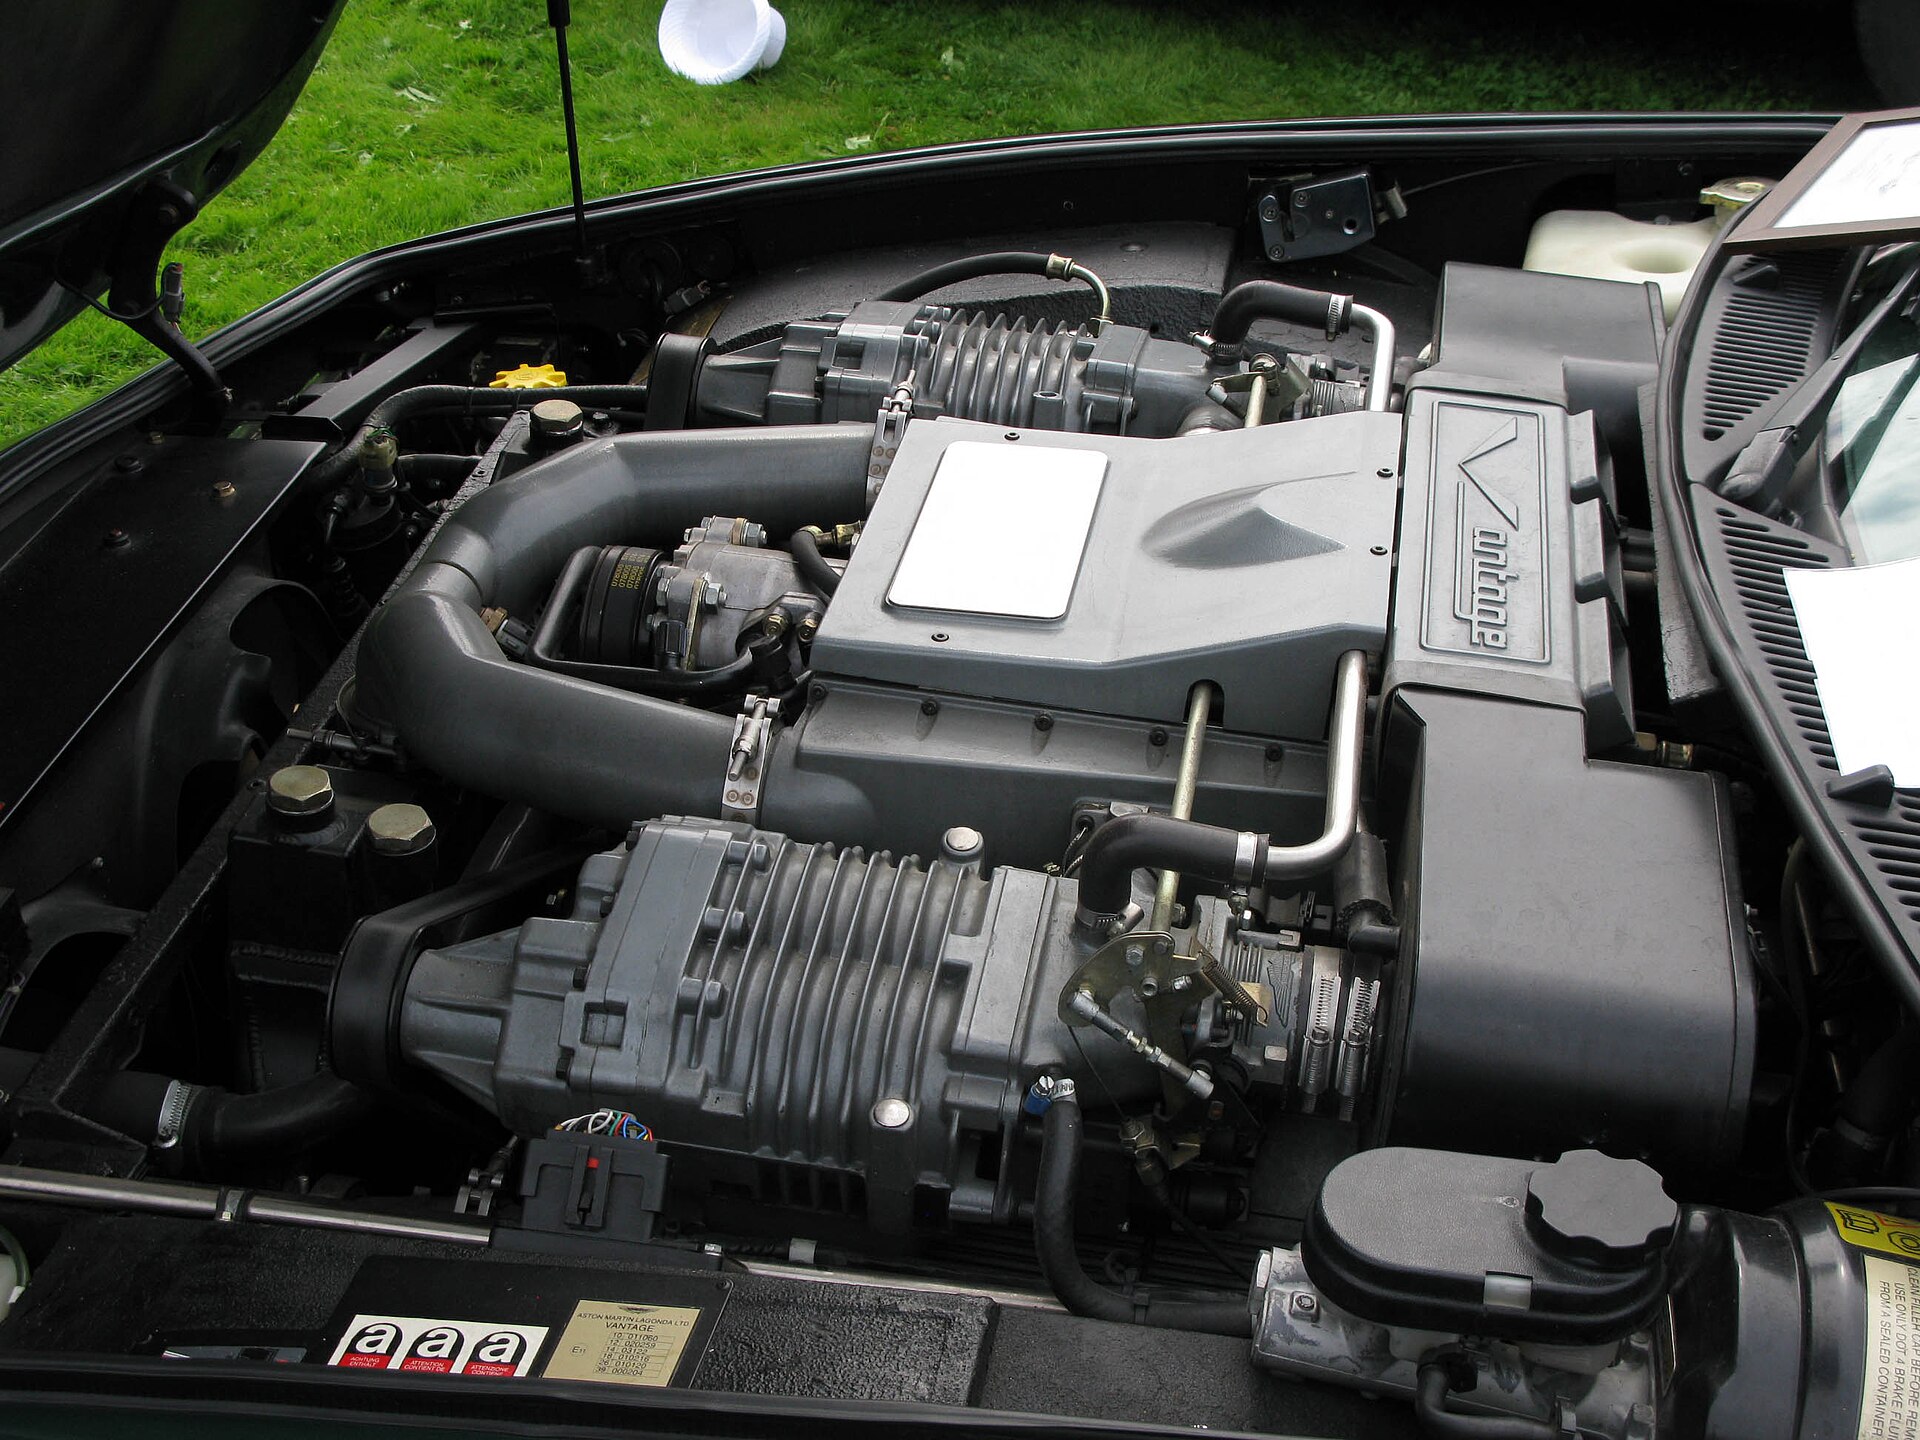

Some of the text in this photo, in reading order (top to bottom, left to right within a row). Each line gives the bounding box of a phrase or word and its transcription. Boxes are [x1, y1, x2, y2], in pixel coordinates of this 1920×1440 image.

[1879, 1280, 1891, 1308] FROM
[1894, 1282, 1905, 1300] USE
[1907, 1267, 1920, 1296] CLEAN
[576, 1312, 604, 1320] ASTON
[604, 1315, 635, 1323] MARTIN
[635, 1317, 673, 1325] LAGONDA
[605, 1322, 656, 1332] VANTAGE
[1895, 1303, 1907, 1331] ONLY
[1911, 1298, 1920, 1331] FILLER
[1879, 1320, 1891, 1364] SEALED
[1896, 1333, 1907, 1356] DOT
[1911, 1334, 1920, 1357] CAP
[1891, 1367, 1905, 1408] BRAKE
[1908, 1359, 1920, 1406] BEFORE
[1887, 1410, 1901, 1440] FLUI
